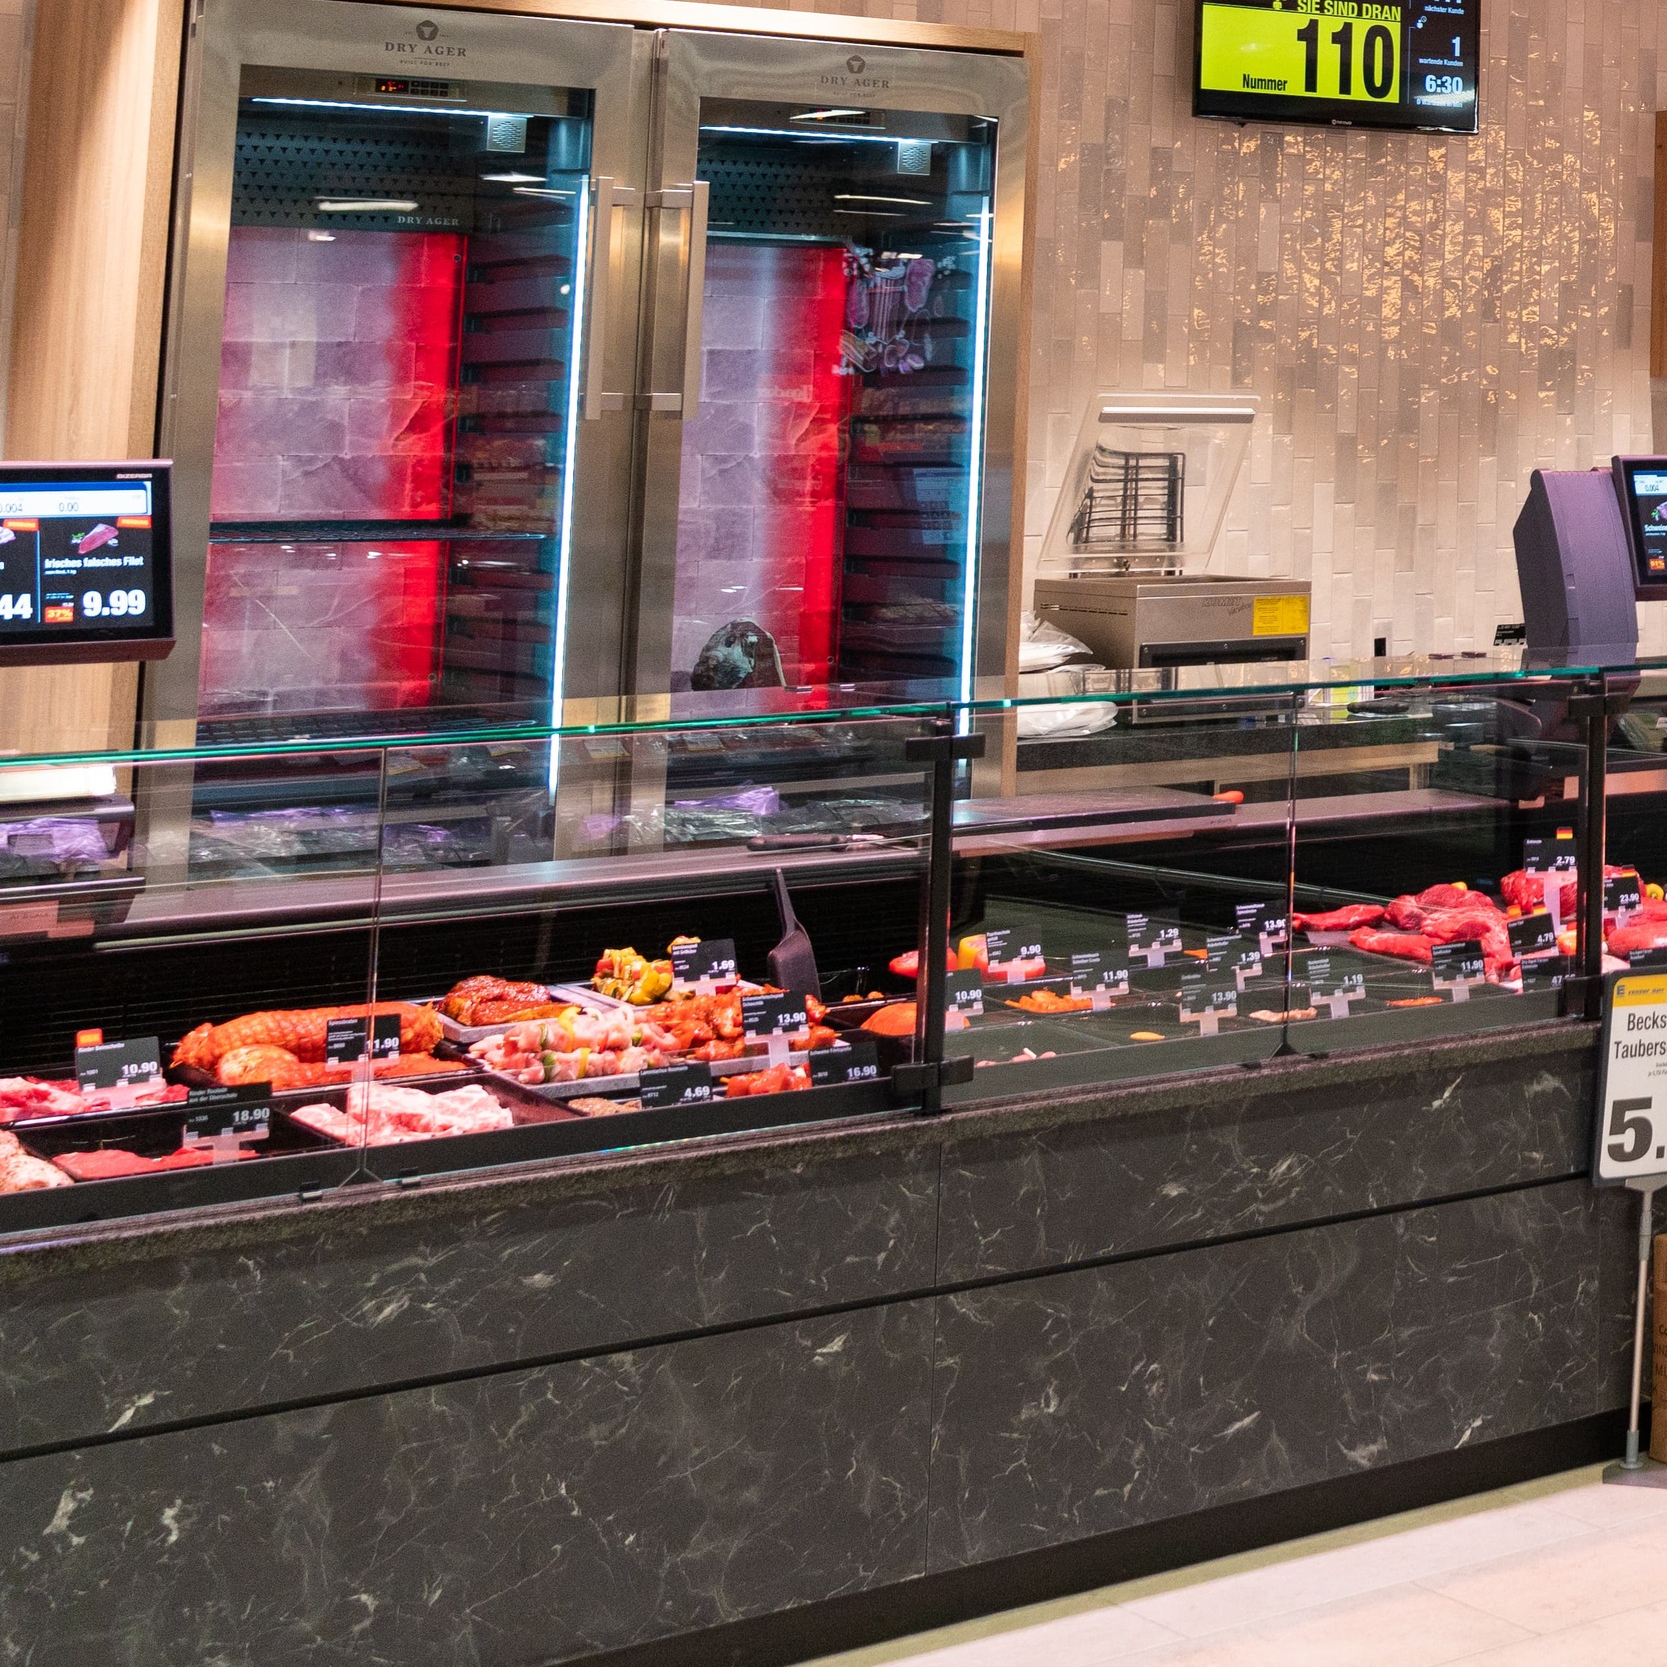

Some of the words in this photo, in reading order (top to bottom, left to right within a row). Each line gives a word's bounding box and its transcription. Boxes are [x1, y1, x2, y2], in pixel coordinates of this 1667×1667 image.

[1324, 0, 1358, 18] SIND
[1361, 3, 1401, 21] DRAN
[385, 42, 417, 53] DRY
[424, 45, 467, 57] AGER
[1452, 36, 1461, 56] 1
[1296, 18, 1395, 99] 110
[821, 75, 848, 85] DRY
[854, 78, 890, 89] AGER
[1242, 73, 1288, 92] Nummer
[1425, 74, 1463, 95] 6:30
[397, 214, 422, 225] DRY
[426, 216, 460, 227] AGER
[83, 556, 122, 568] falsches
[123, 555, 144, 567] Filet
[82, 588, 147, 618] 9.99
[47, 609, 73, 619] 37%
[1159, 927, 1179, 940] 1.29
[1020, 944, 1041, 956] 9.90
[1240, 951, 1261, 963] 1.39
[711, 959, 735, 970] 1.69
[1461, 959, 1484, 971] 11.90
[1103, 969, 1129, 981] 11.90
[1343, 973, 1364, 985] 1.19
[955, 988, 982, 1000] 10.90
[1212, 989, 1237, 1001] 13.90
[778, 1011, 806, 1024] 13.90
[121, 1060, 158, 1076] 10.90
[847, 1065, 877, 1078] 16.90
[684, 1086, 710, 1098] 4.69
[232, 1107, 270, 1123] 18.90
